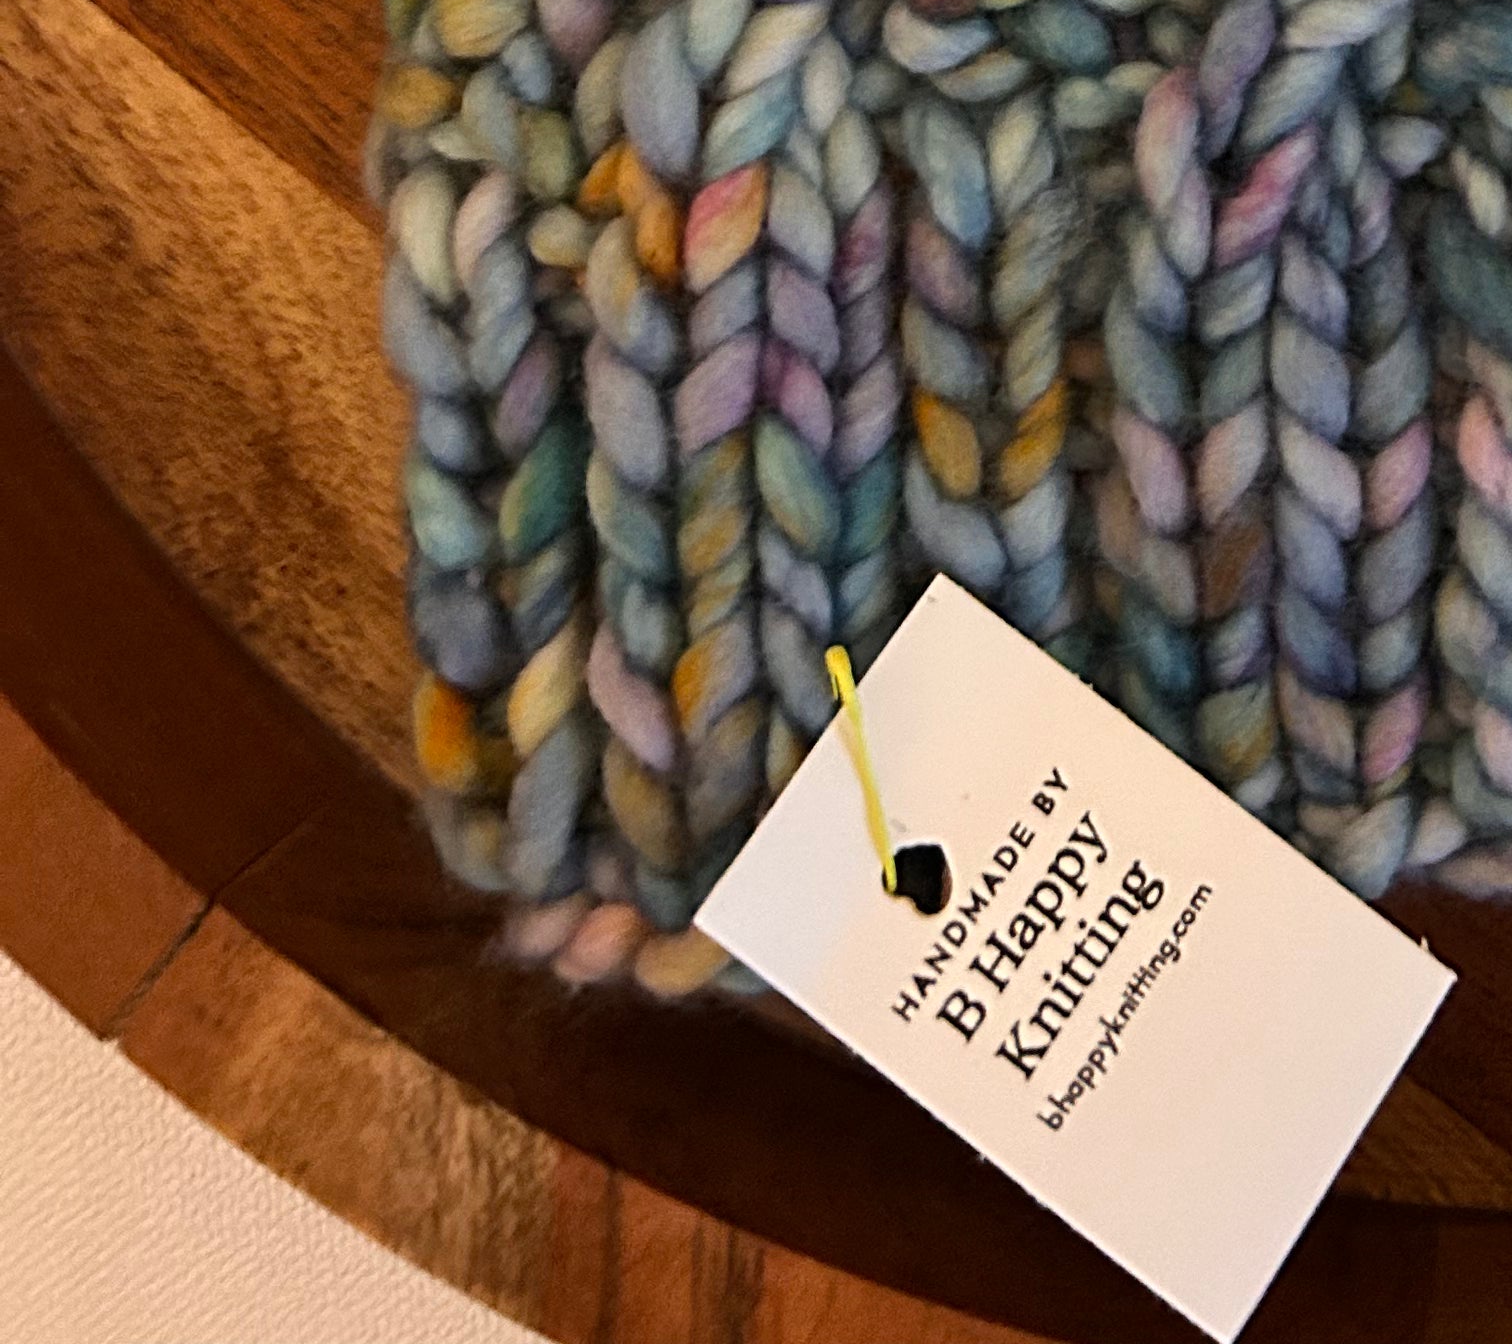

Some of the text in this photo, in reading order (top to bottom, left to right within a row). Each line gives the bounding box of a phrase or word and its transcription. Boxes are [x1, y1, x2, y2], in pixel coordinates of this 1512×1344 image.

[891, 767, 1069, 1023] HANDMADE BY
[935, 810, 1108, 1044] B Happy
[994, 859, 1165, 1081] Knitting
[1036, 884, 1213, 1132] bhappyknitting.com
